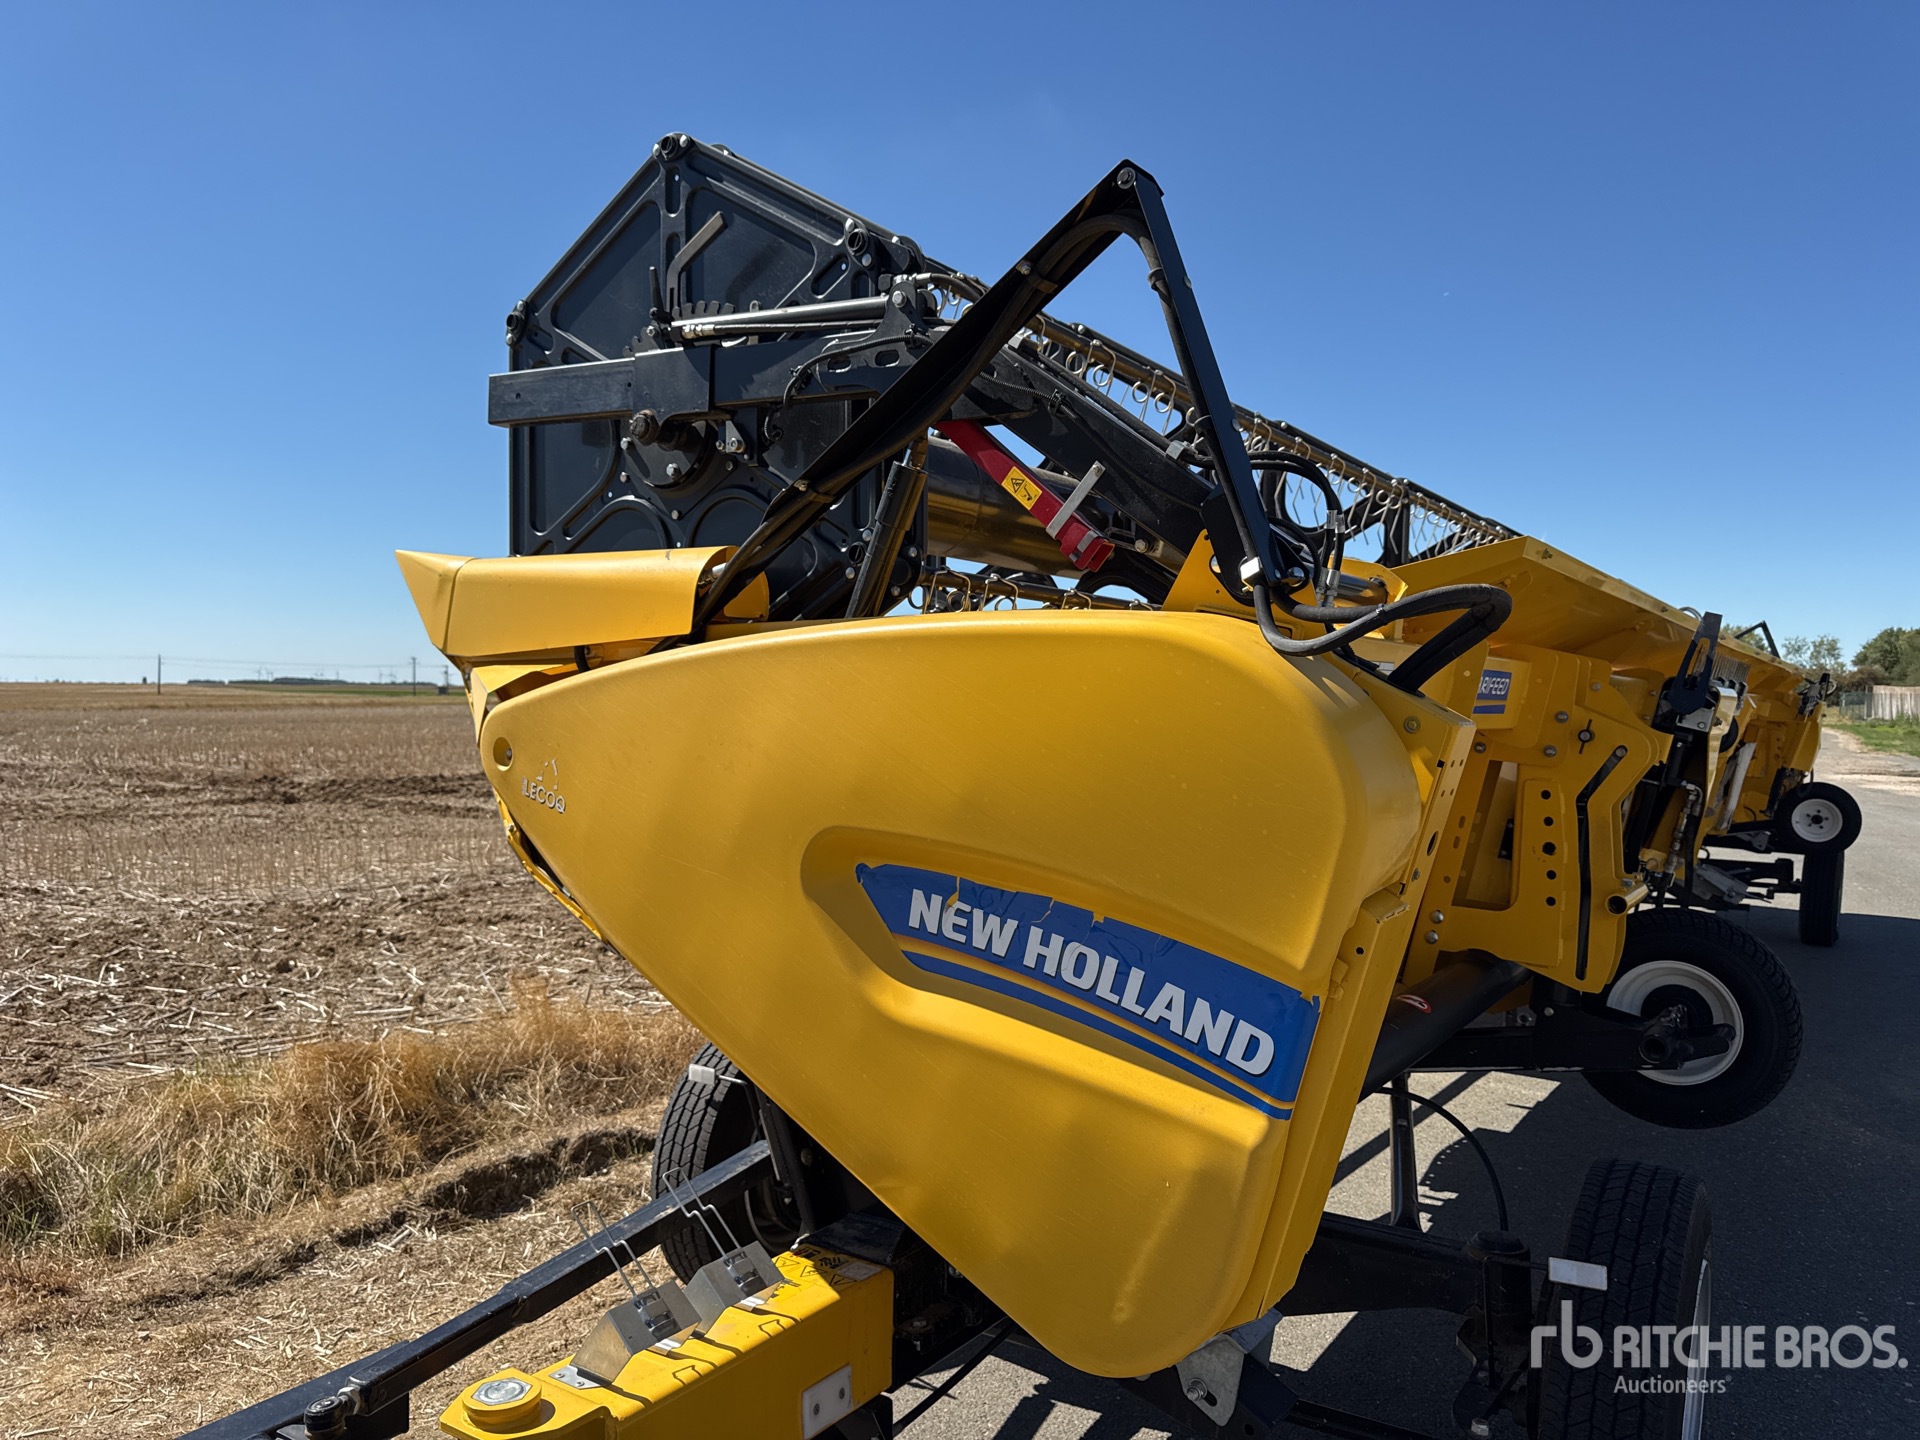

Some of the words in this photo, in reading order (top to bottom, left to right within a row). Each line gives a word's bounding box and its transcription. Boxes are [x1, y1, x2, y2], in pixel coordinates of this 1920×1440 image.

[521, 776, 566, 814] LECOQ
[908, 888, 1018, 957] NEW
[1023, 925, 1275, 1077] HOLLAND
